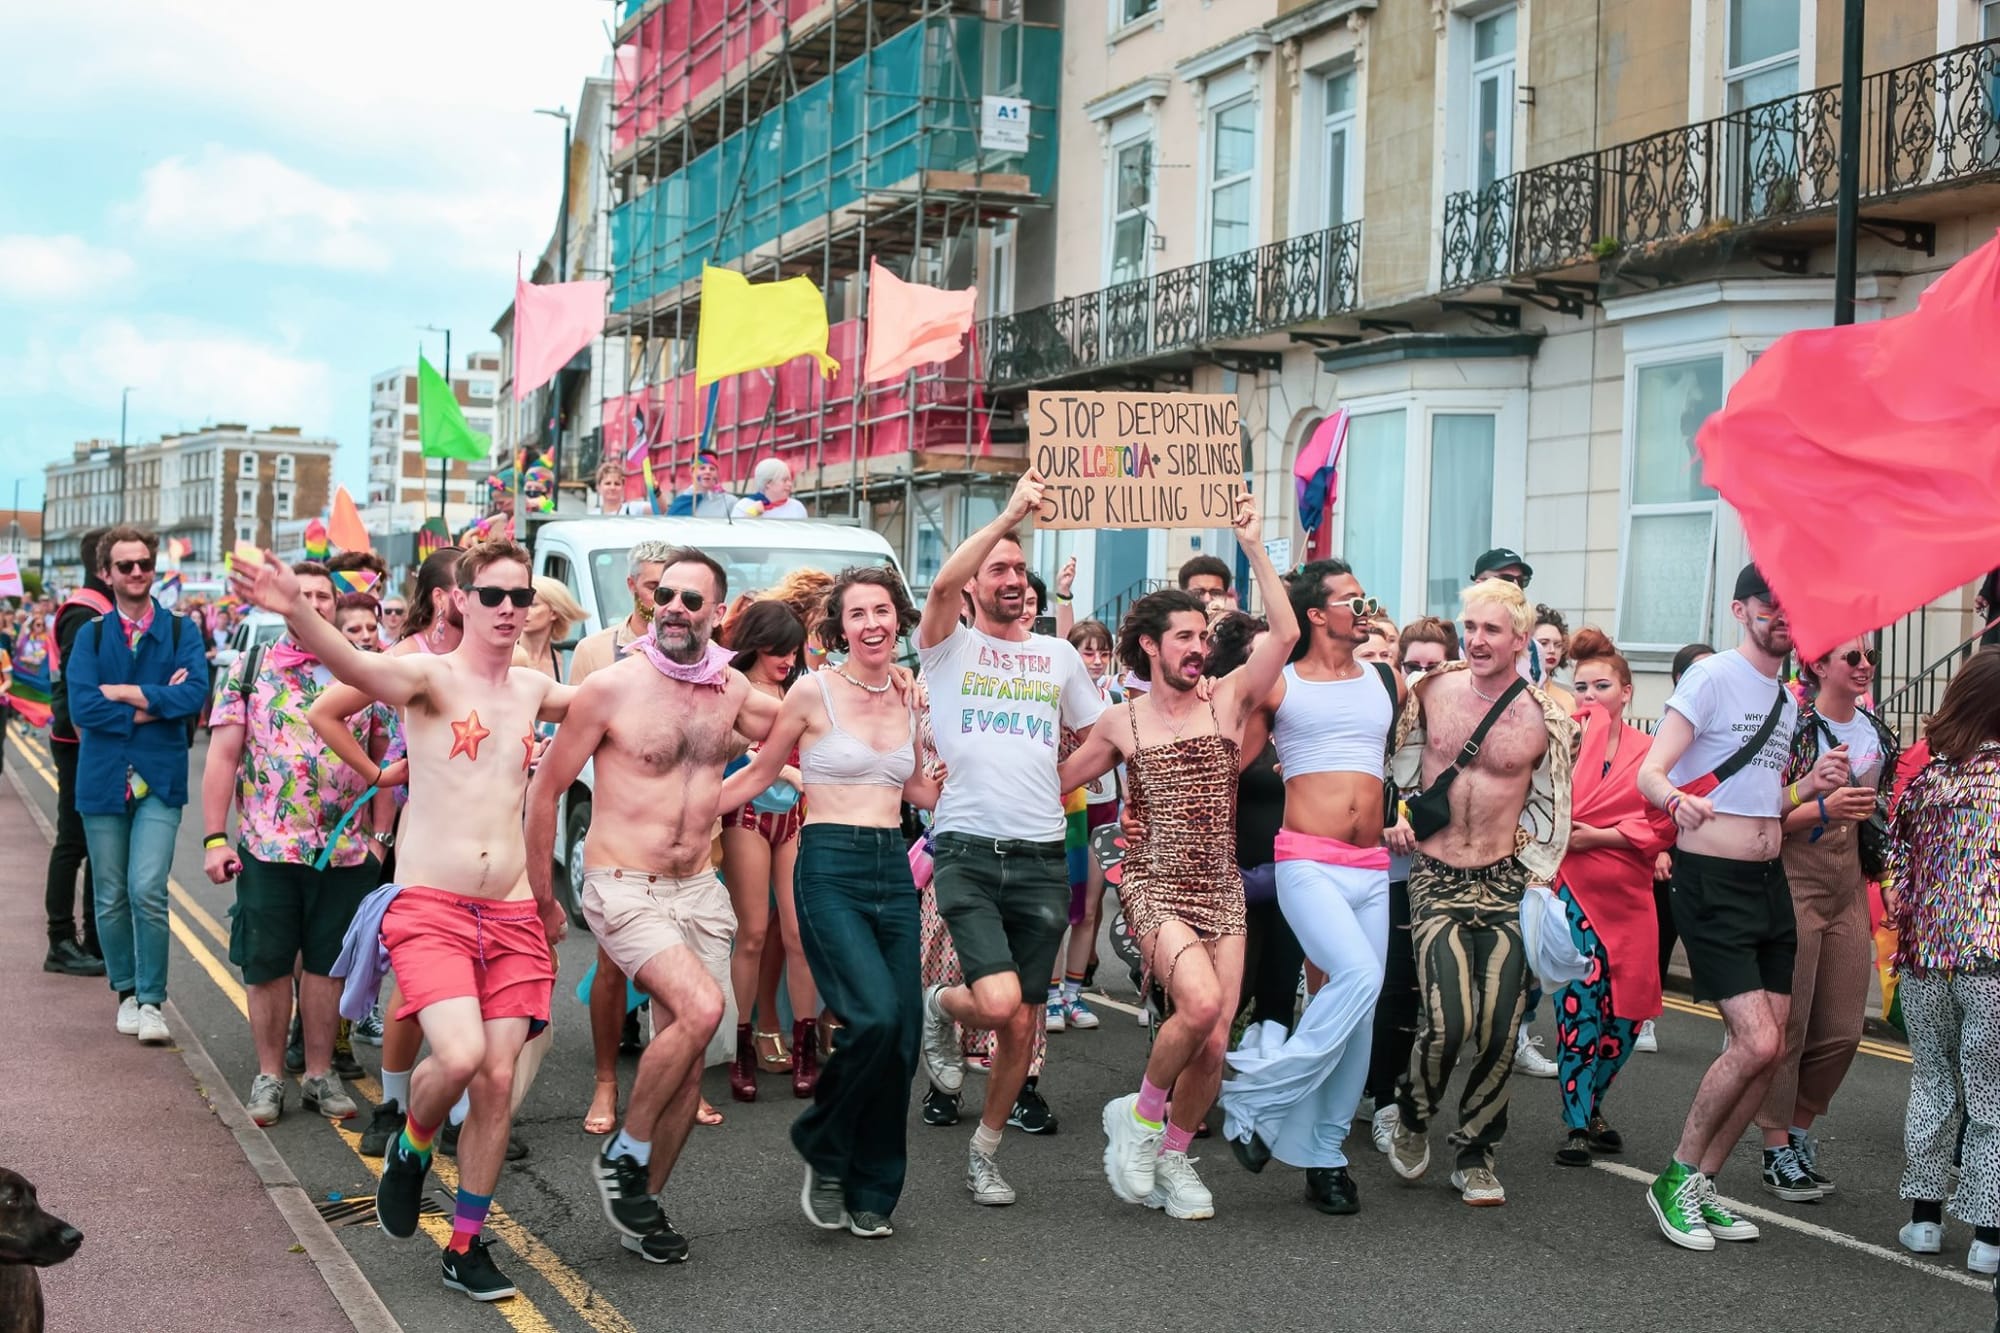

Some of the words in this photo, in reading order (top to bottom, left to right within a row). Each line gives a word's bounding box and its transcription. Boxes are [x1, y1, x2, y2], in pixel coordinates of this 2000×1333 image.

[997, 105, 1018, 119] A1
[1039, 397, 1105, 438] STOP
[1117, 400, 1239, 438] DEPORTING
[1037, 444, 1080, 479] OUR
[1082, 442, 1161, 479] LGBTQIA+
[1167, 442, 1241, 476] SIBLINGS
[1040, 485, 1095, 522] STOP
[1105, 485, 1187, 523] KILLING
[978, 646, 1051, 674] LISTEN
[961, 671, 1061, 711] EMPATHISE
[961, 708, 1054, 748] EVOLVE
[1744, 713, 1763, 721] WHY
